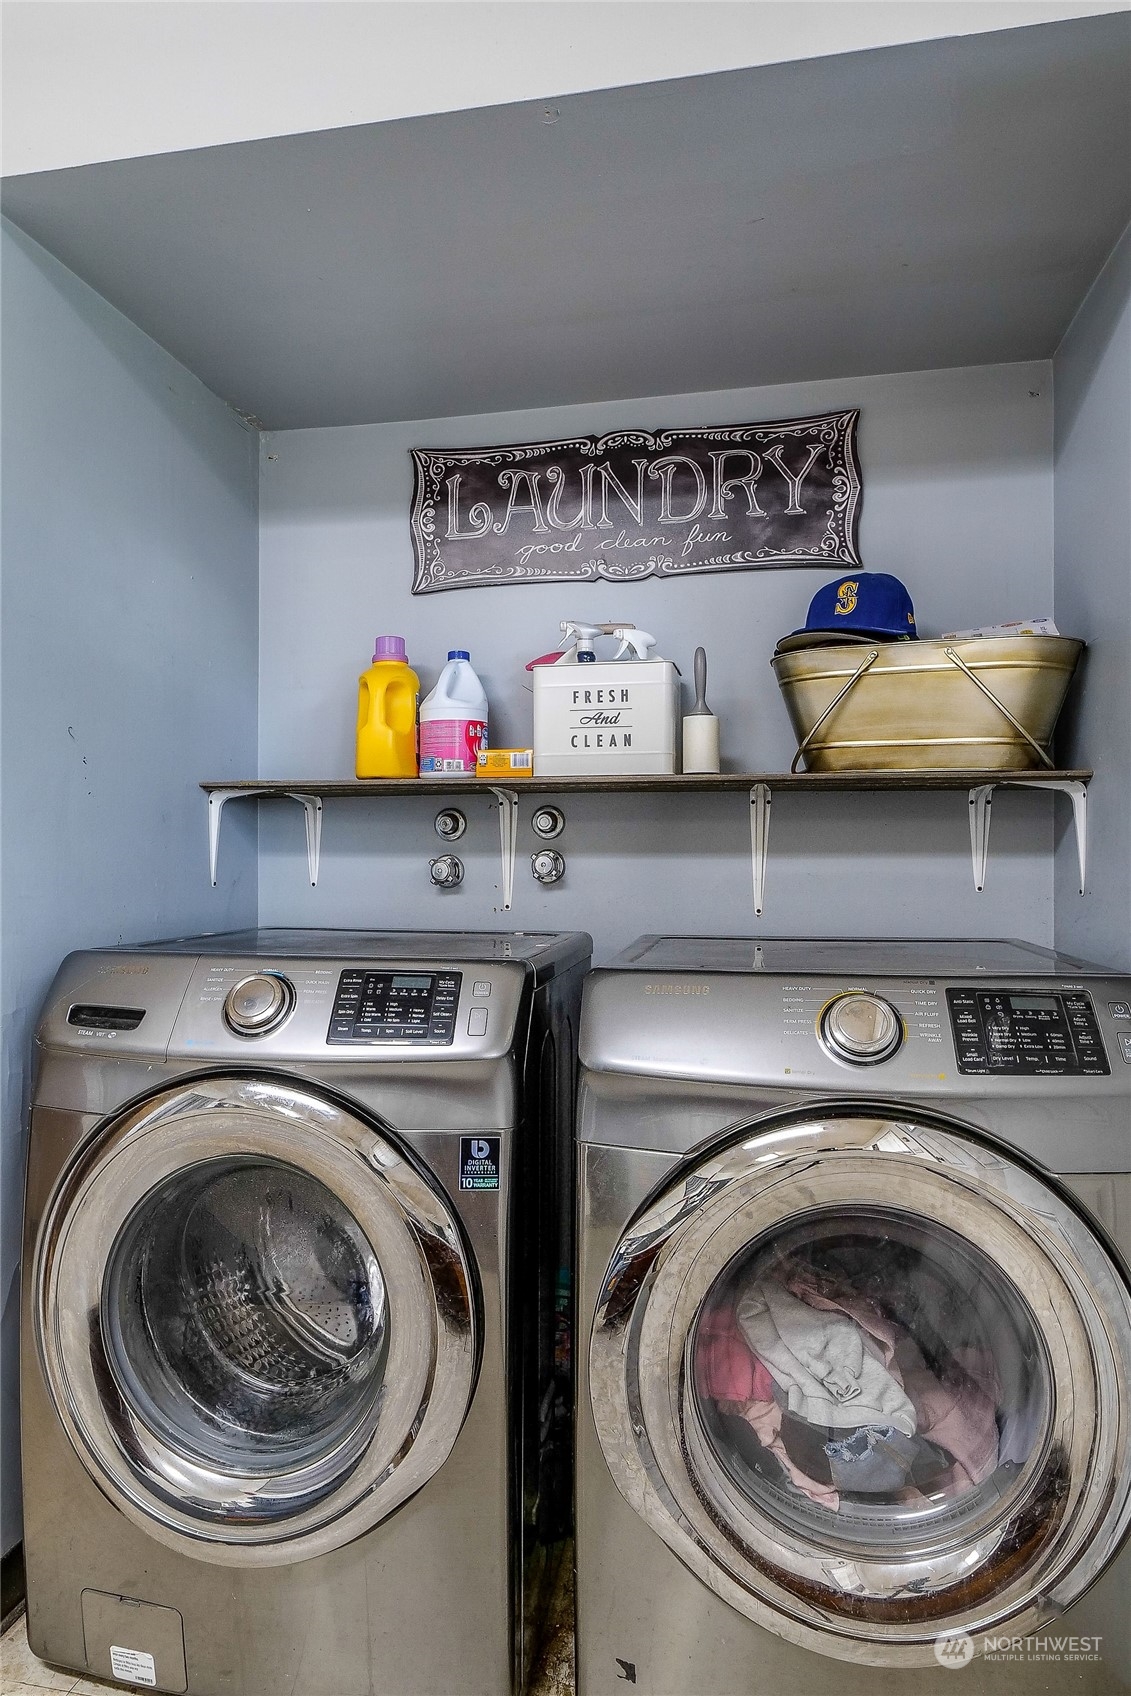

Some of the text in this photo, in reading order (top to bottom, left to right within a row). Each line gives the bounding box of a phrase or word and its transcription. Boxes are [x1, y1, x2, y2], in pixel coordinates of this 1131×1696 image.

[445, 444, 825, 540] LAUNDRY
[516, 524, 732, 563] good clean fun
[573, 689, 629, 704] FRESH
[580, 712, 621, 725] And
[571, 734, 632, 748] CLEAN
[644, 985, 710, 995] SAMSUNG
[462, 1178, 473, 1188] 10
